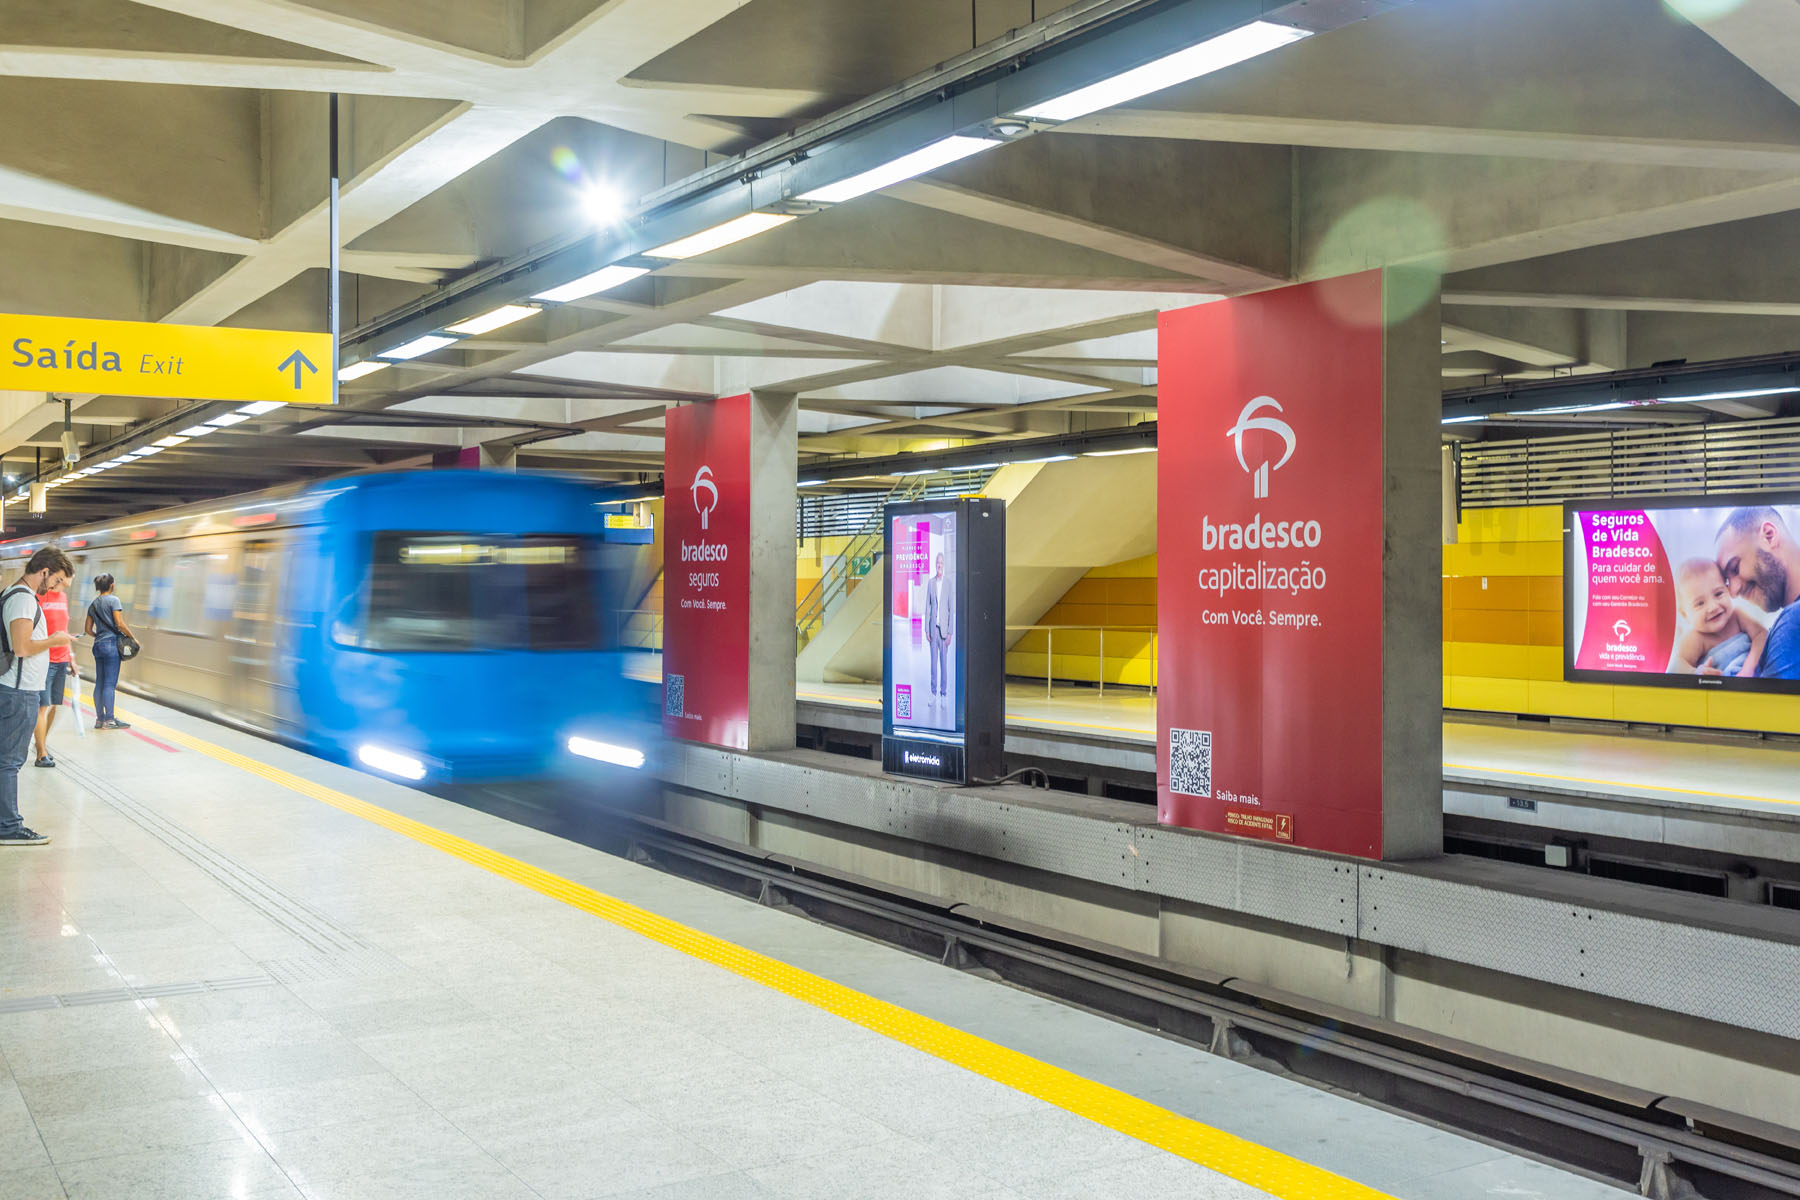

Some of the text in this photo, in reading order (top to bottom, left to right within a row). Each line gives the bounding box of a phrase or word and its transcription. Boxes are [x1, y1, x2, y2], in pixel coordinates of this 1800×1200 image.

[12, 338, 184, 375] Saída Exit
[1592, 514, 1644, 529] Seguros
[1202, 512, 1322, 550] bradesco
[1592, 528, 1639, 542] de Vida
[681, 538, 728, 562] bradesco
[1592, 545, 1653, 558] Bradesco.
[1592, 562, 1656, 573] Para cuidar de
[689, 572, 719, 592] seguros
[1198, 560, 1327, 598] capitalização
[1592, 573, 1665, 586] quem você ama.
[681, 598, 728, 612] Com Você. Sempre.
[1202, 609, 1322, 630] Com Você. Sempre.
[1606, 643, 1637, 652] bradesco
[1216, 789, 1261, 806] Saiba mais.
